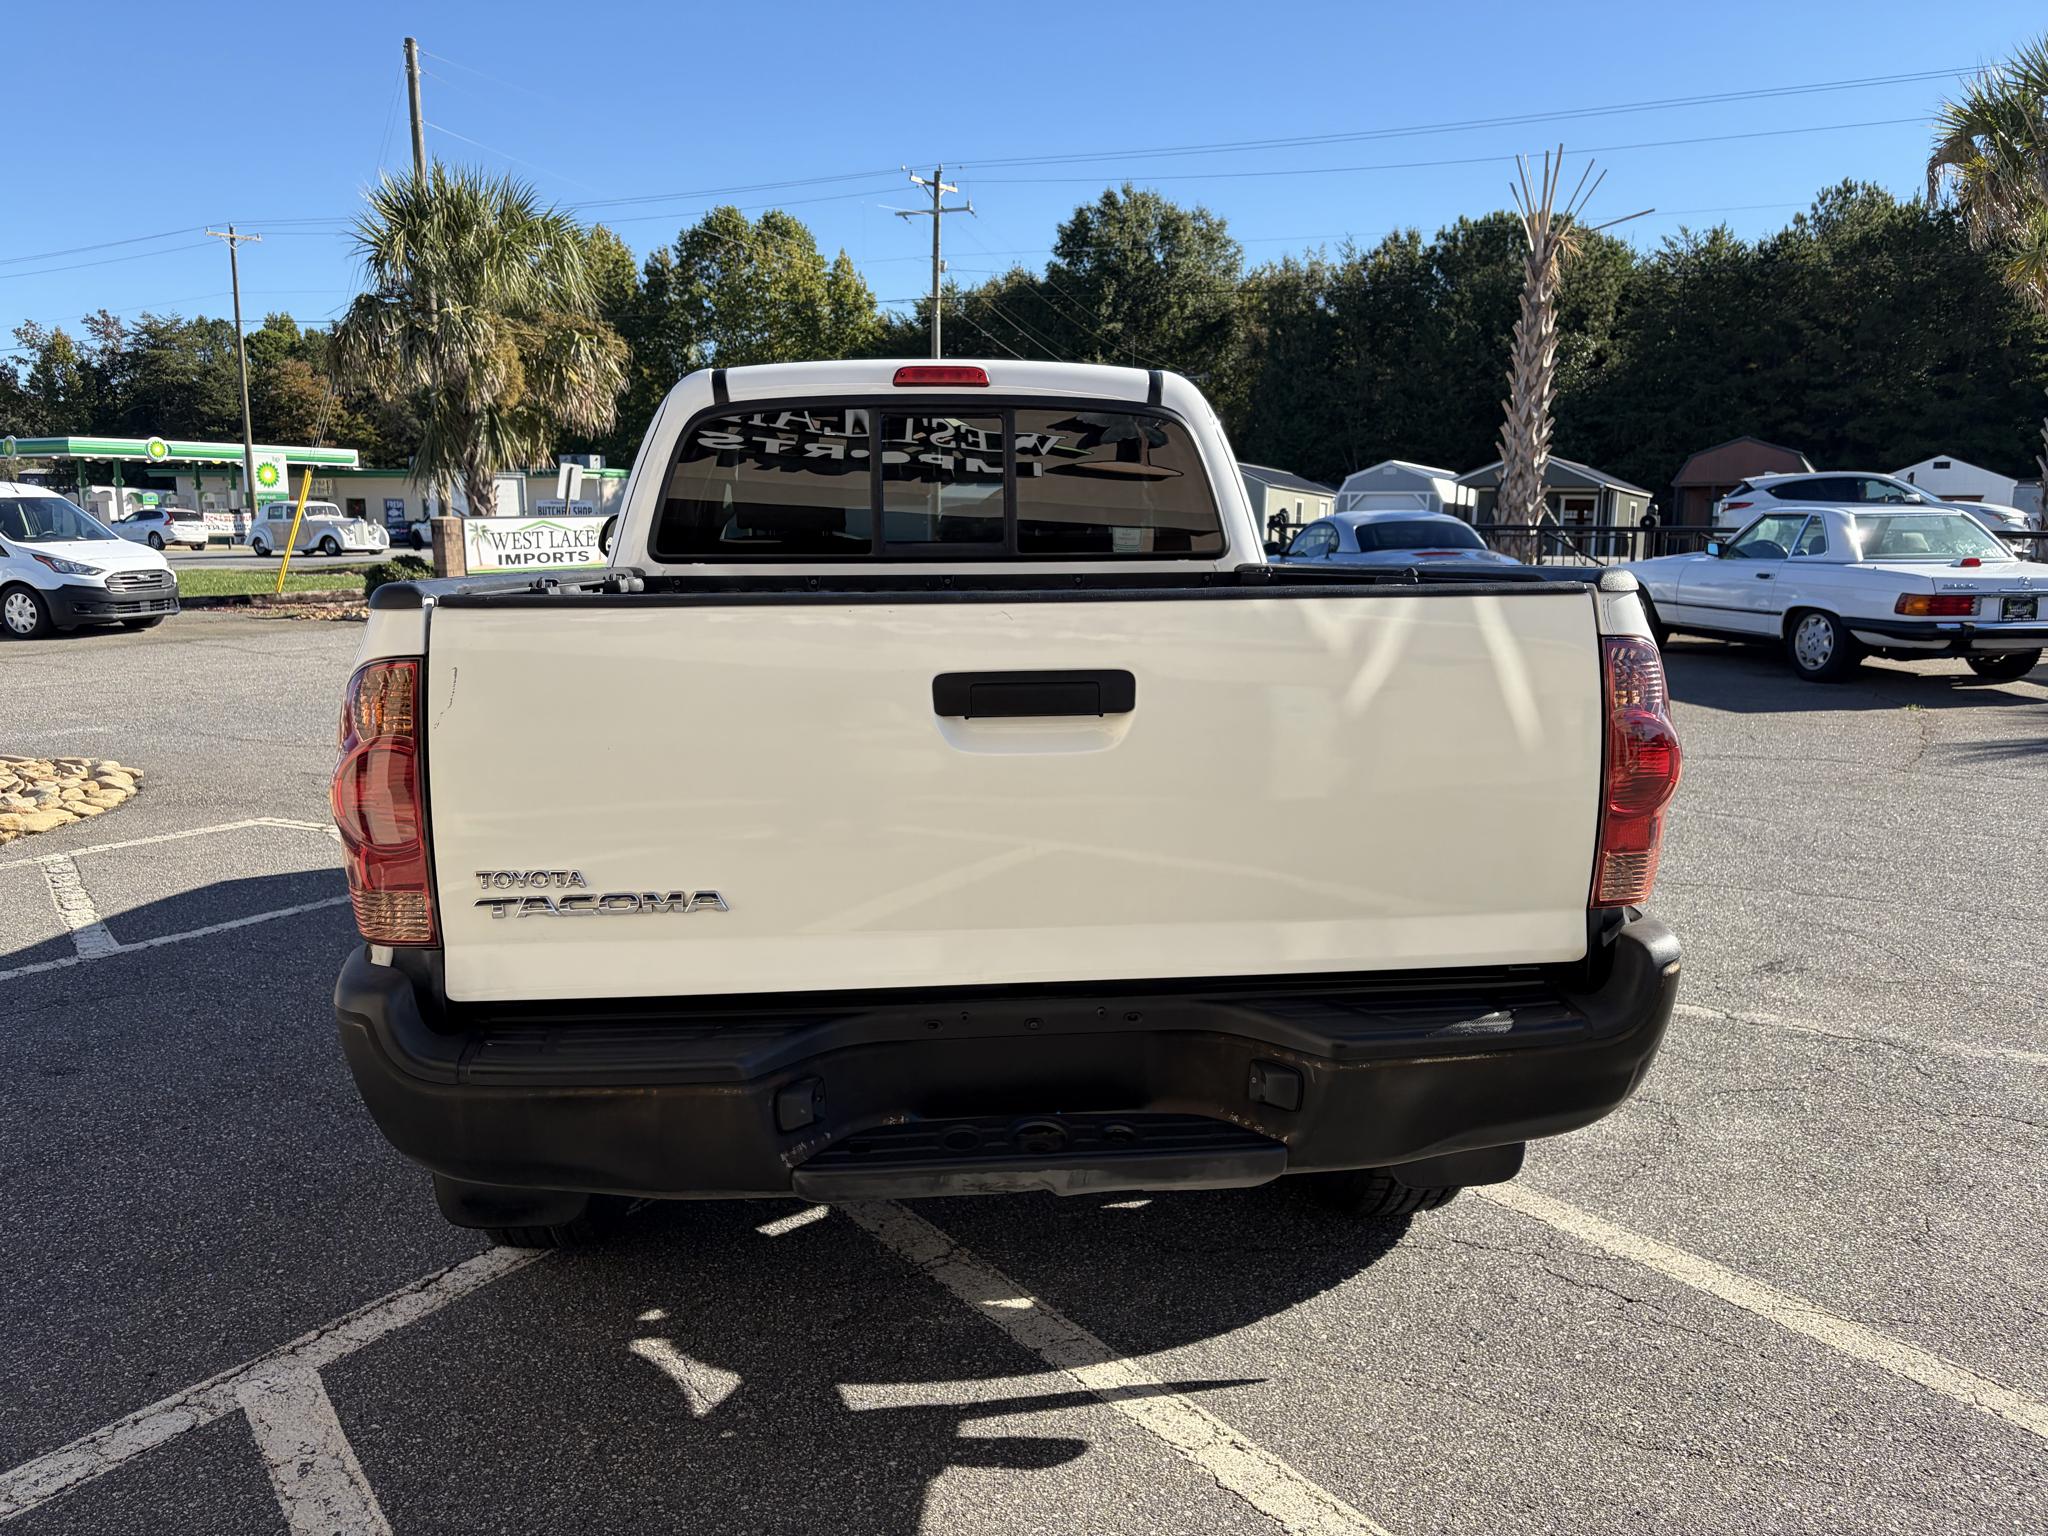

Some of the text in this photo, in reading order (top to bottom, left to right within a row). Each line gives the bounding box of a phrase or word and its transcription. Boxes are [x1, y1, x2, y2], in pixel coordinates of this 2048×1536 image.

[572, 506, 593, 516] SHOP
[490, 529, 597, 551] WEST LAKE
[498, 550, 590, 566] IMPORTS
[474, 869, 588, 890] TOYOTA
[472, 889, 731, 920] TACOMA
